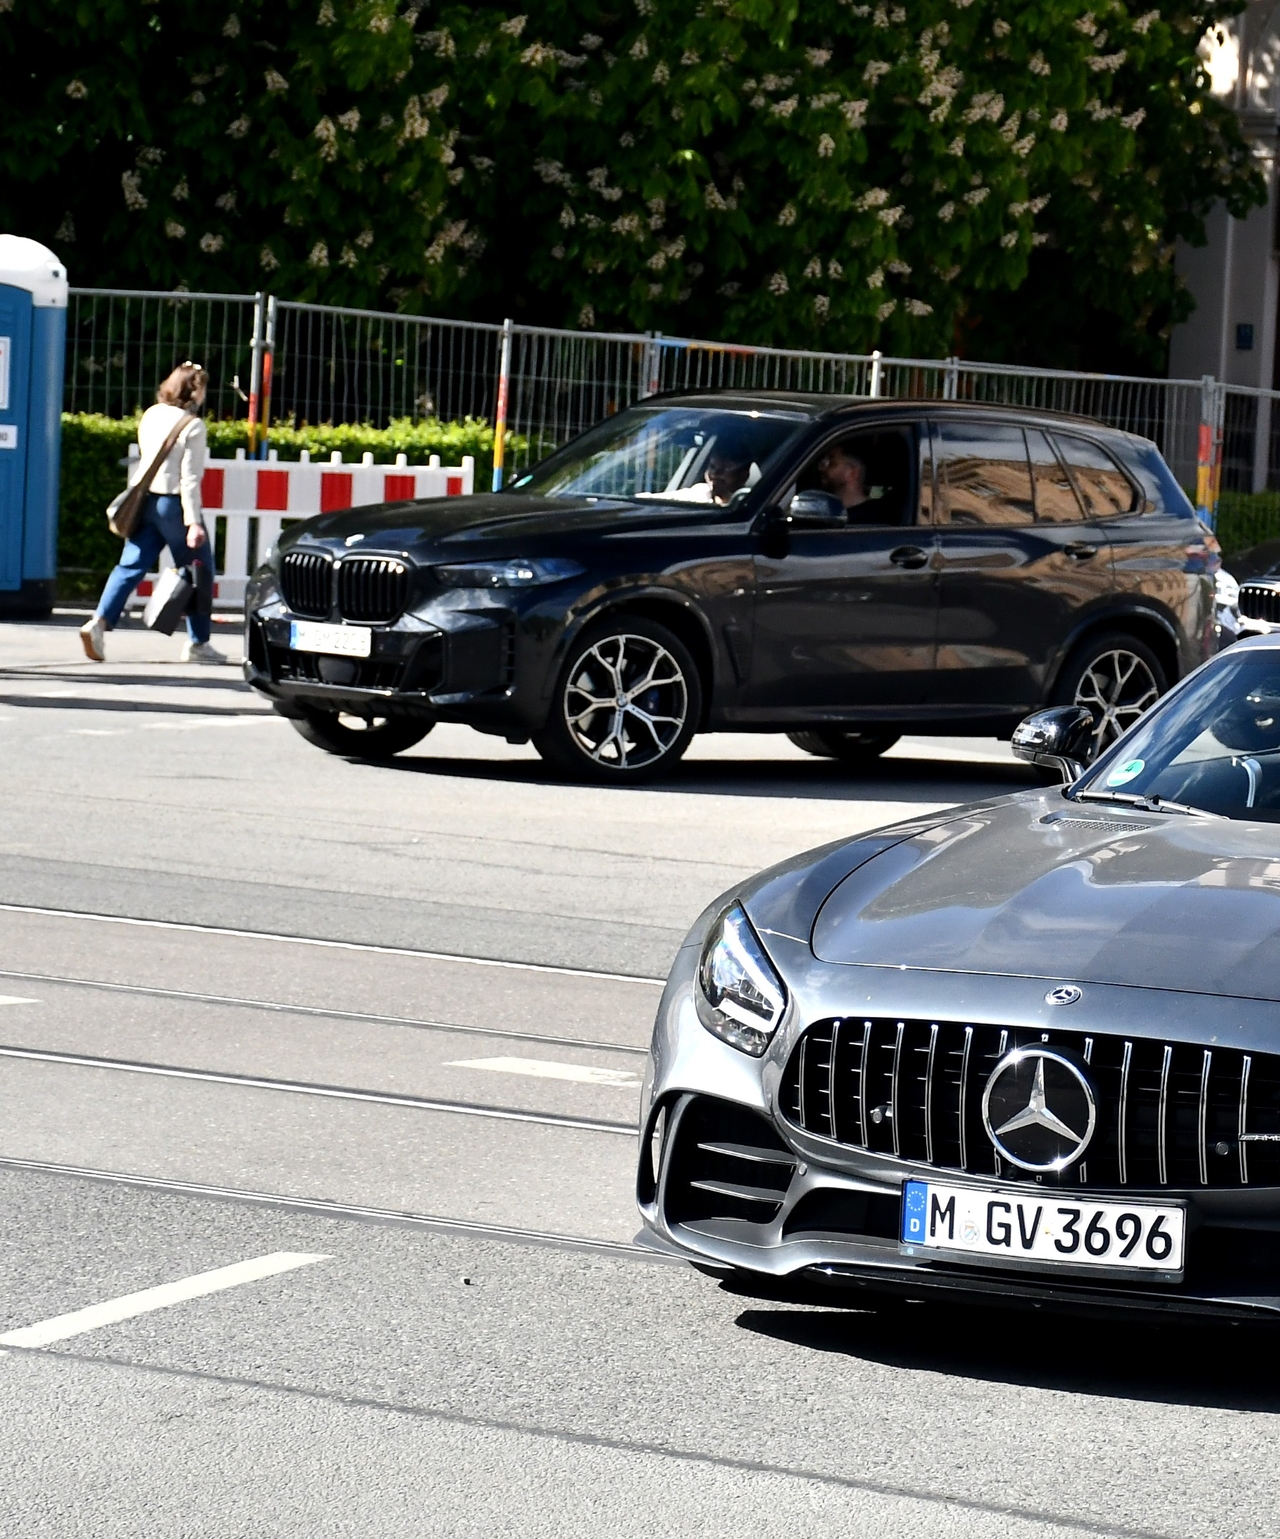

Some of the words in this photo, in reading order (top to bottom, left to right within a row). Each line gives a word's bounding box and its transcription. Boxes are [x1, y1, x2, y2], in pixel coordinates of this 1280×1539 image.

[910, 1218, 920, 1232] D
[930, 1193, 956, 1240] M
[985, 1201, 1043, 1250] GV
[1054, 1207, 1173, 1261] 3696
